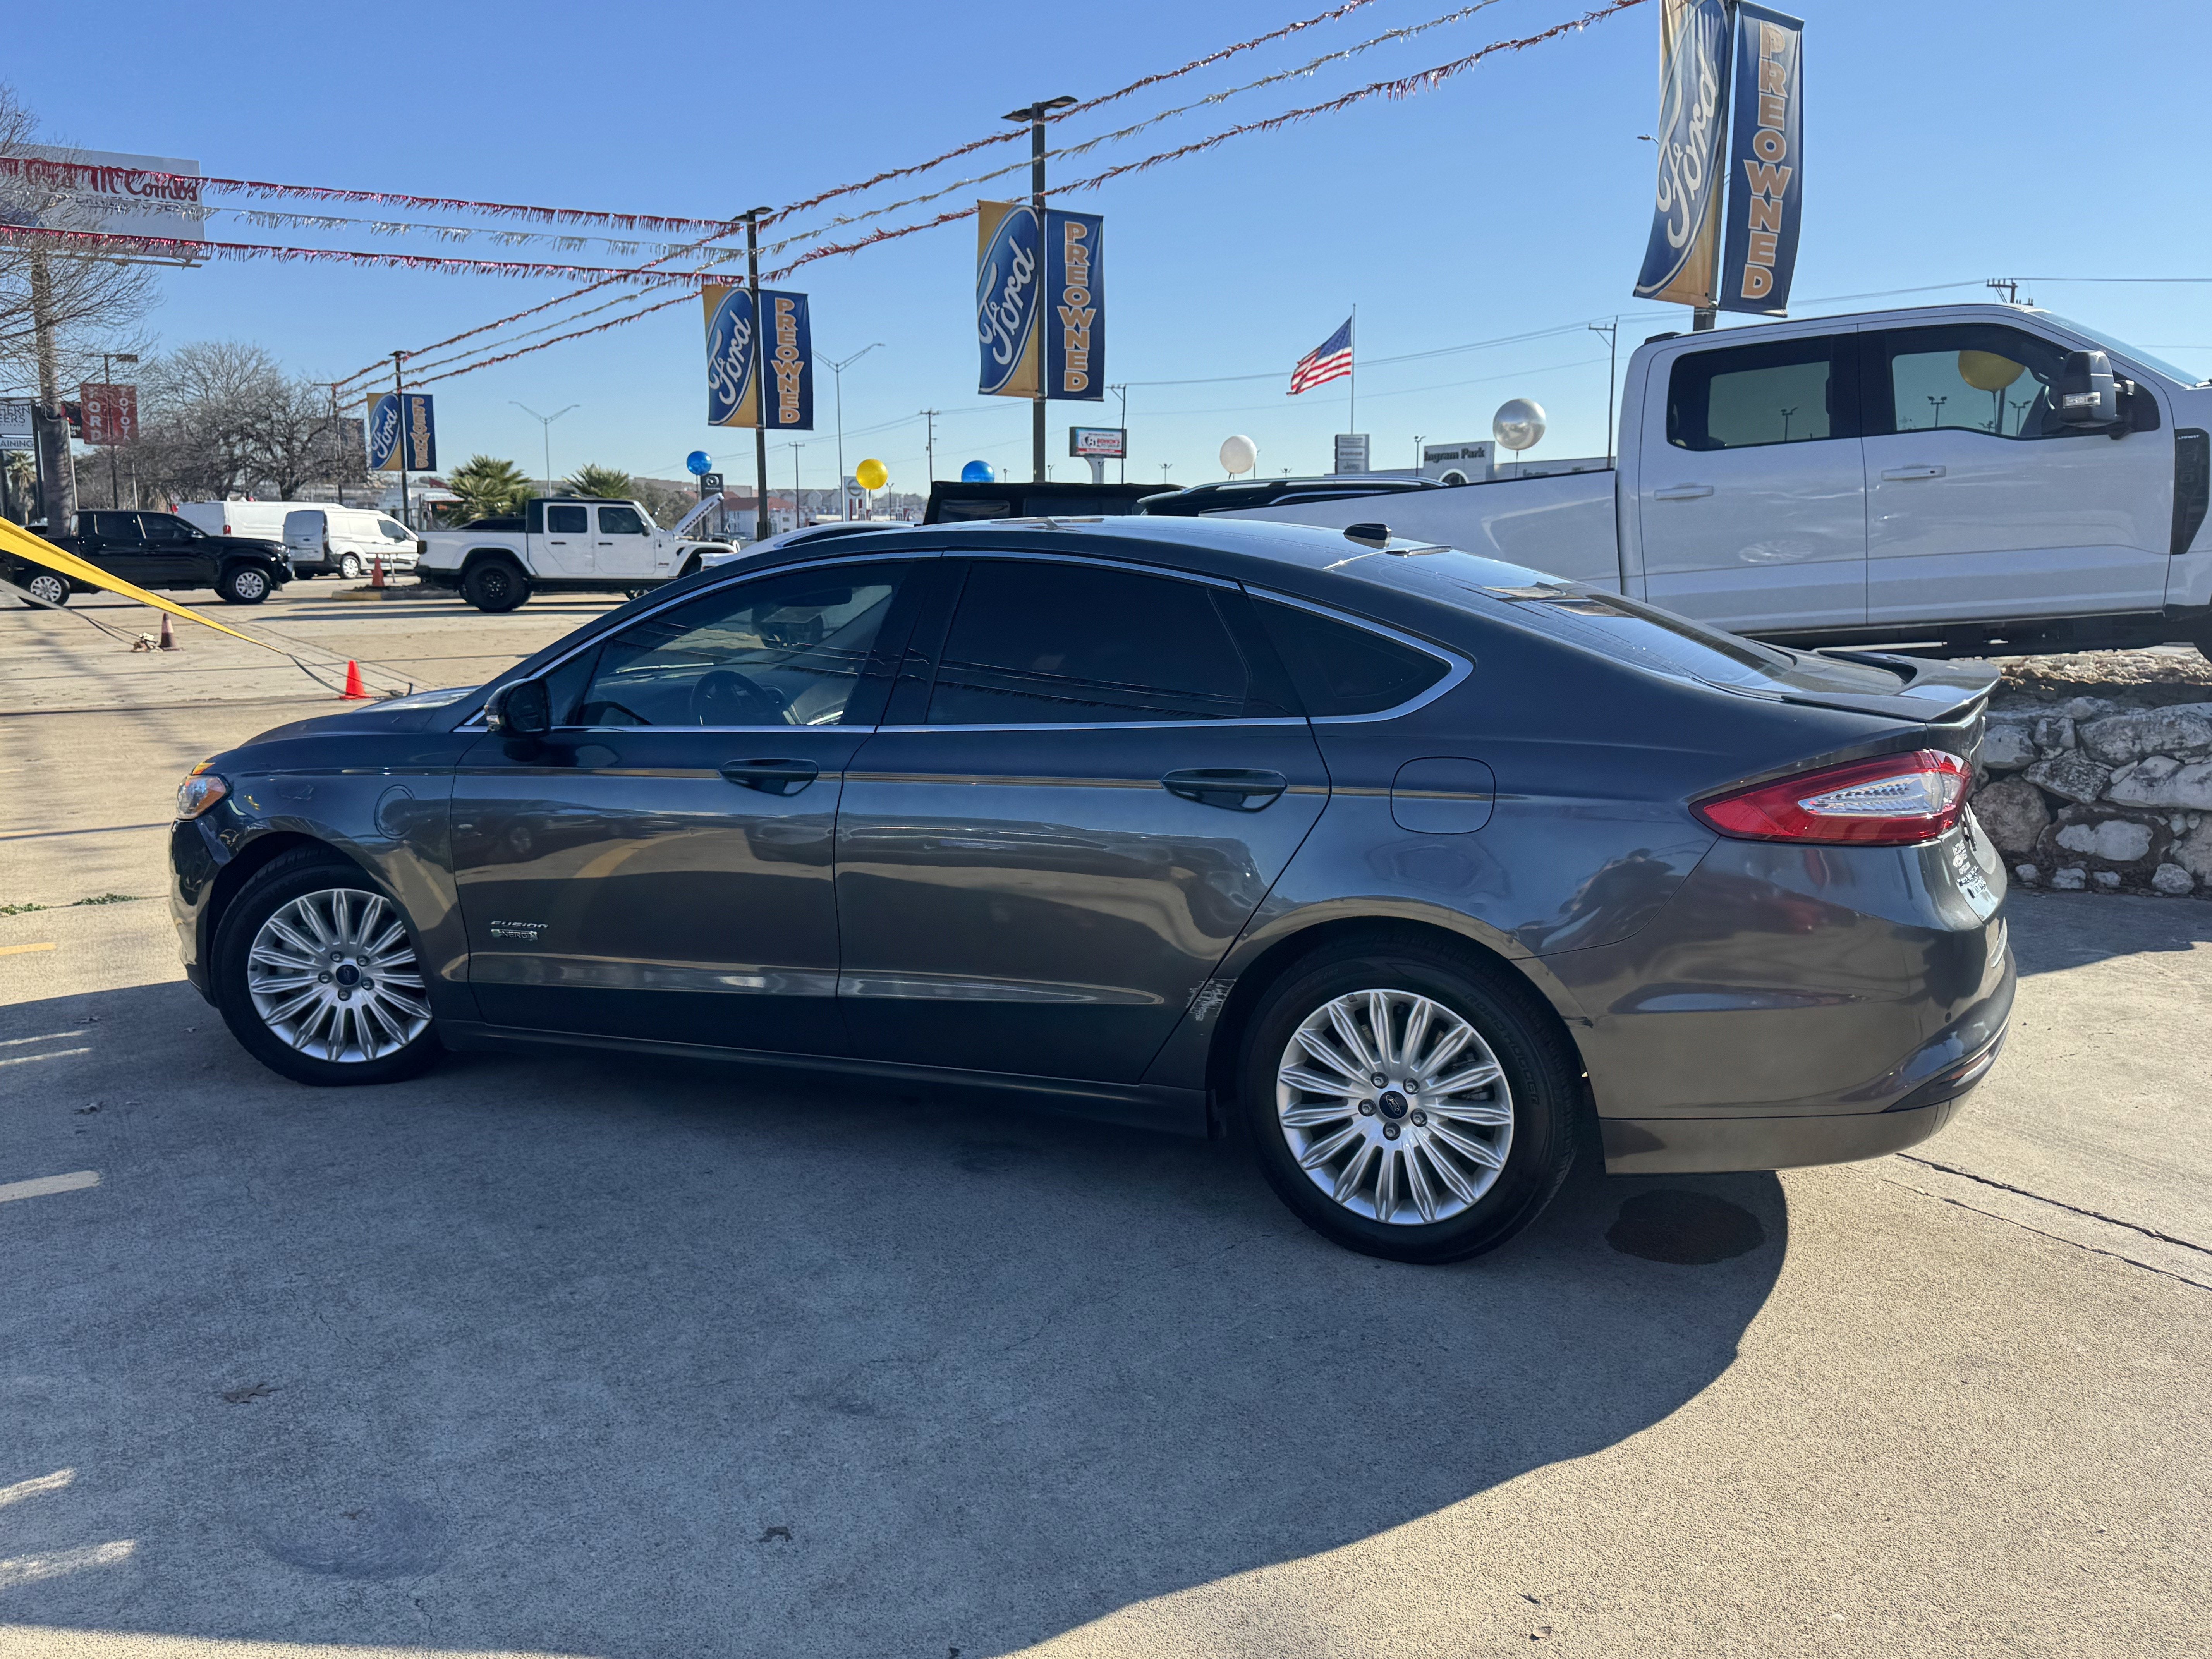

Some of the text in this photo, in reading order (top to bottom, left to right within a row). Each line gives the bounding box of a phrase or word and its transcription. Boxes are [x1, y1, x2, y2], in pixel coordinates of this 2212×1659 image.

[1656, 41, 1719, 249] Ford
[1741, 21, 1792, 299] PREOWNED
[979, 235, 1035, 364] Ford
[1057, 221, 1096, 392] PREOWNED
[708, 310, 752, 405] Ford
[770, 297, 804, 424] PREOWNED
[371, 405, 398, 459] Ford
[410, 397, 431, 469] PREOWNED
[1425, 447, 1485, 463] Ingram Park
[491, 921, 548, 929] FUSION
